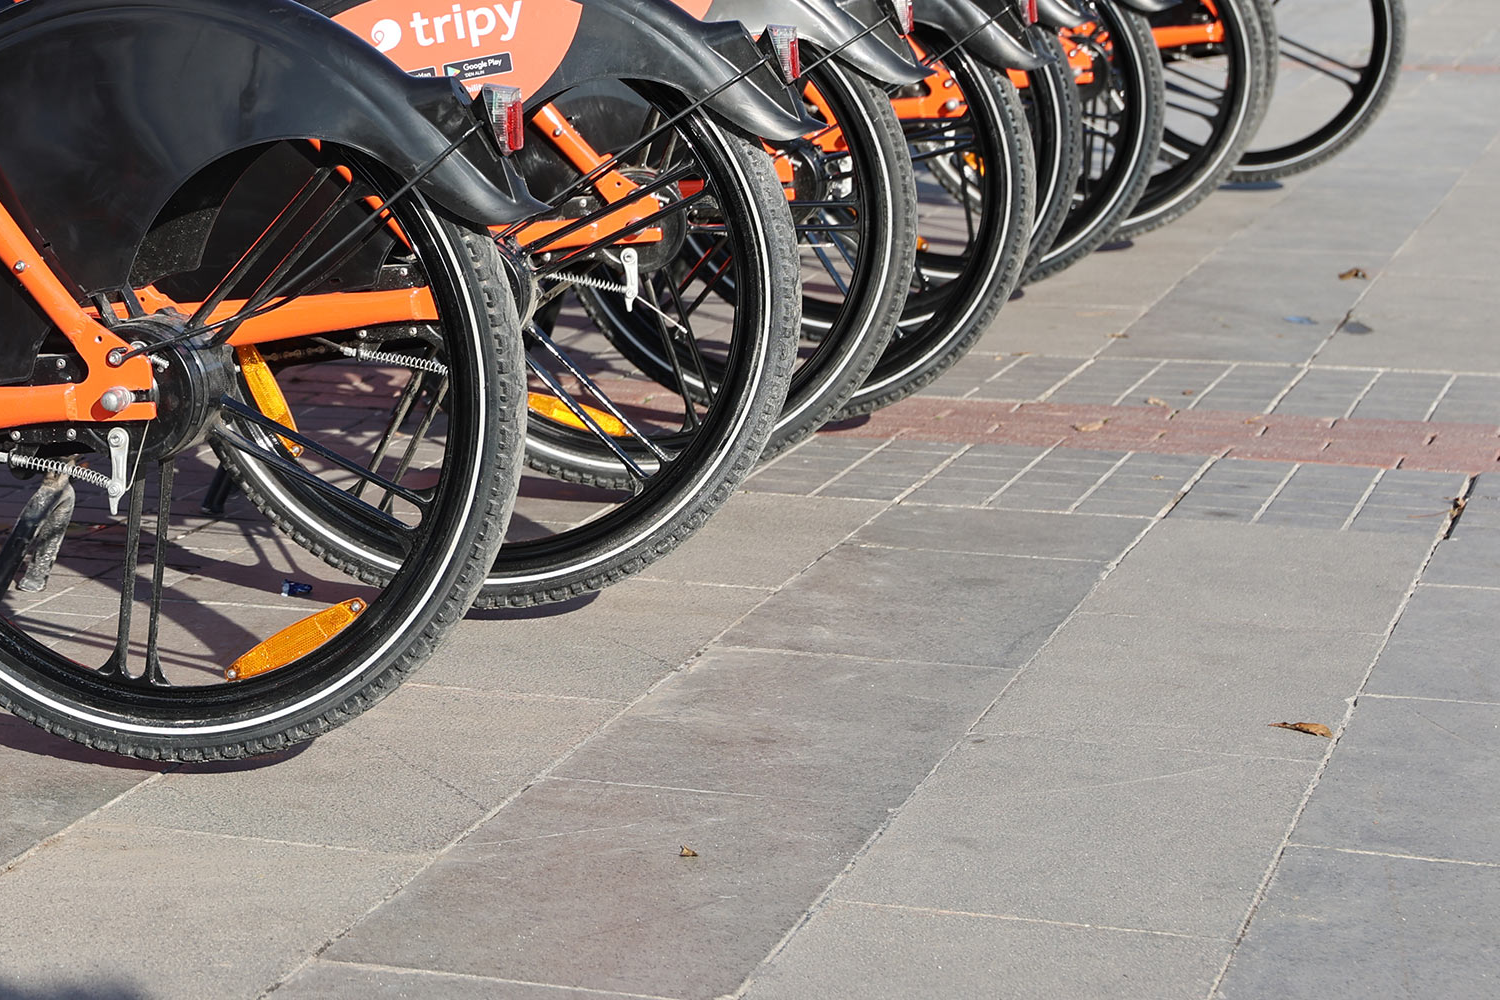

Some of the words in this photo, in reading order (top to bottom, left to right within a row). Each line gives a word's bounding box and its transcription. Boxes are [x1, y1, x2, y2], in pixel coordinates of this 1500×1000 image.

[409, 0, 523, 48] tripy
[463, 60, 488, 71] Google
[488, 58, 503, 67] Play
